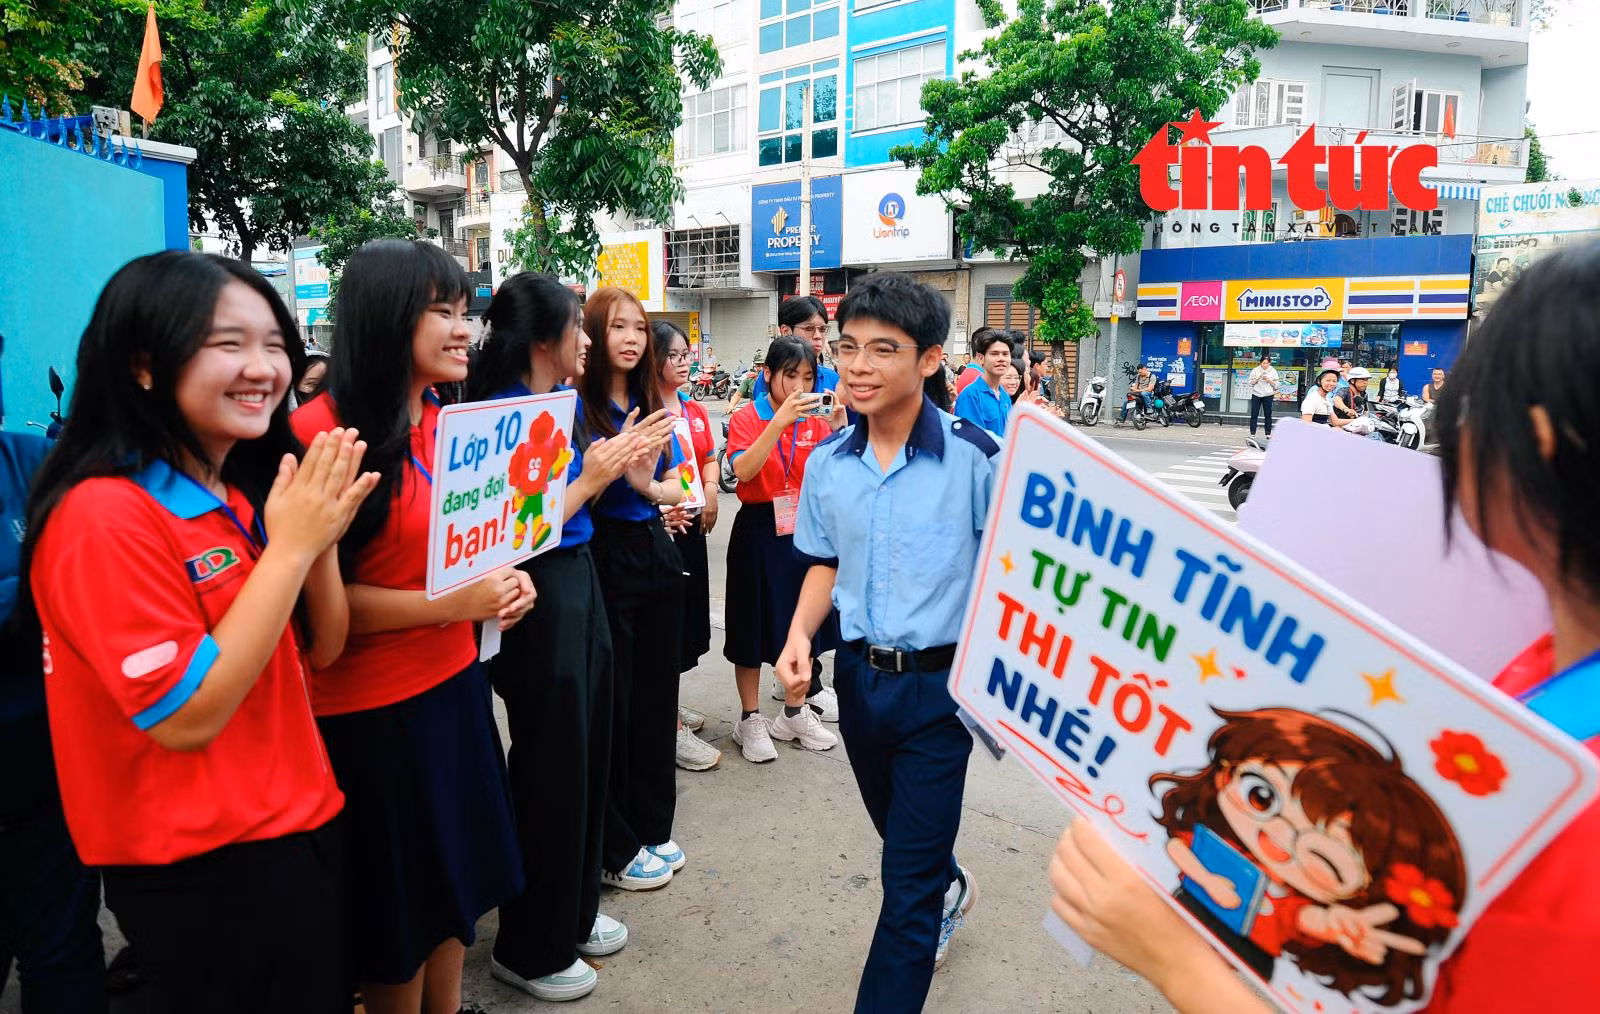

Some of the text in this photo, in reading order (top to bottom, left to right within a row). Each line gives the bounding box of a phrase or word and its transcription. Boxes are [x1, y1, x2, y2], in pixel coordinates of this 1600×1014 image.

[1486, 192, 1509, 213] CHÈ
[1513, 186, 1552, 211] CHUỐI
[768, 234, 821, 249] PROPETY
[873, 226, 910, 239] Liontrip
[1245, 295, 1324, 307] MINISTOP
[448, 411, 523, 472] Lớp 10
[443, 473, 505, 515] đang đợi
[443, 499, 509, 569] bạn!
[1020, 472, 1326, 684] BÌNH TĨNH
[1030, 549, 1179, 663] TỰ TIN
[997, 592, 1193, 758] THI TỐT
[986, 657, 1117, 780] NHÉ!
